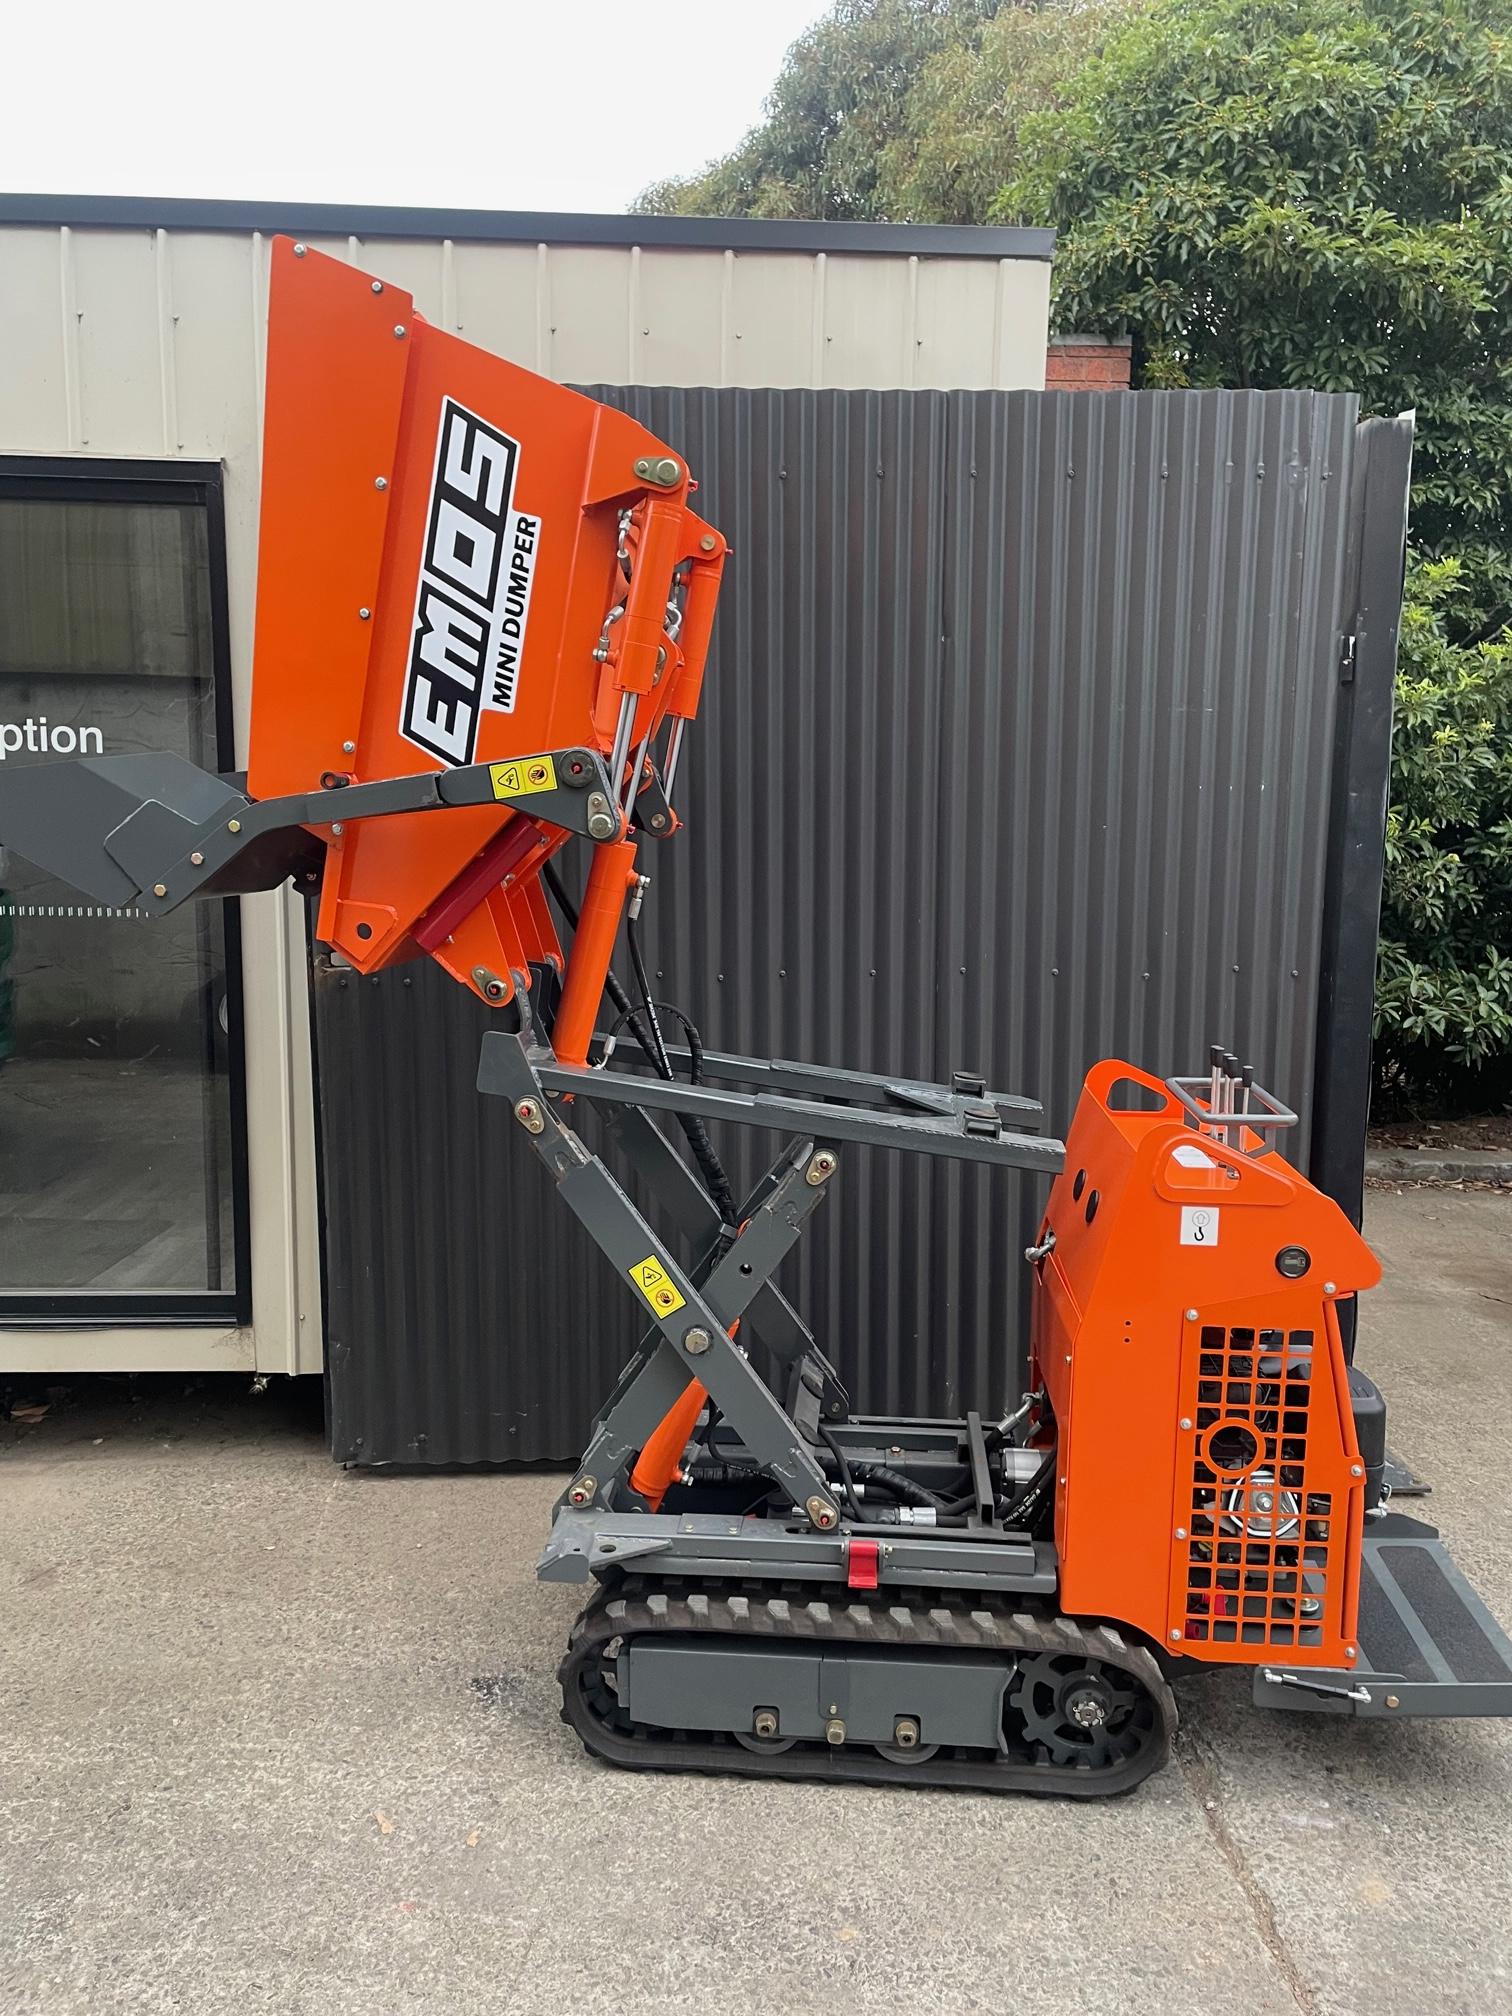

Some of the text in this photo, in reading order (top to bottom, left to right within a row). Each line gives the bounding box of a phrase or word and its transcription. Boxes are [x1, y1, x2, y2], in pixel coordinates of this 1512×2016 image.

[410, 413, 510, 754] EMOS
[492, 516, 537, 708] MINI DUMPER
[0, 717, 104, 760] ption
